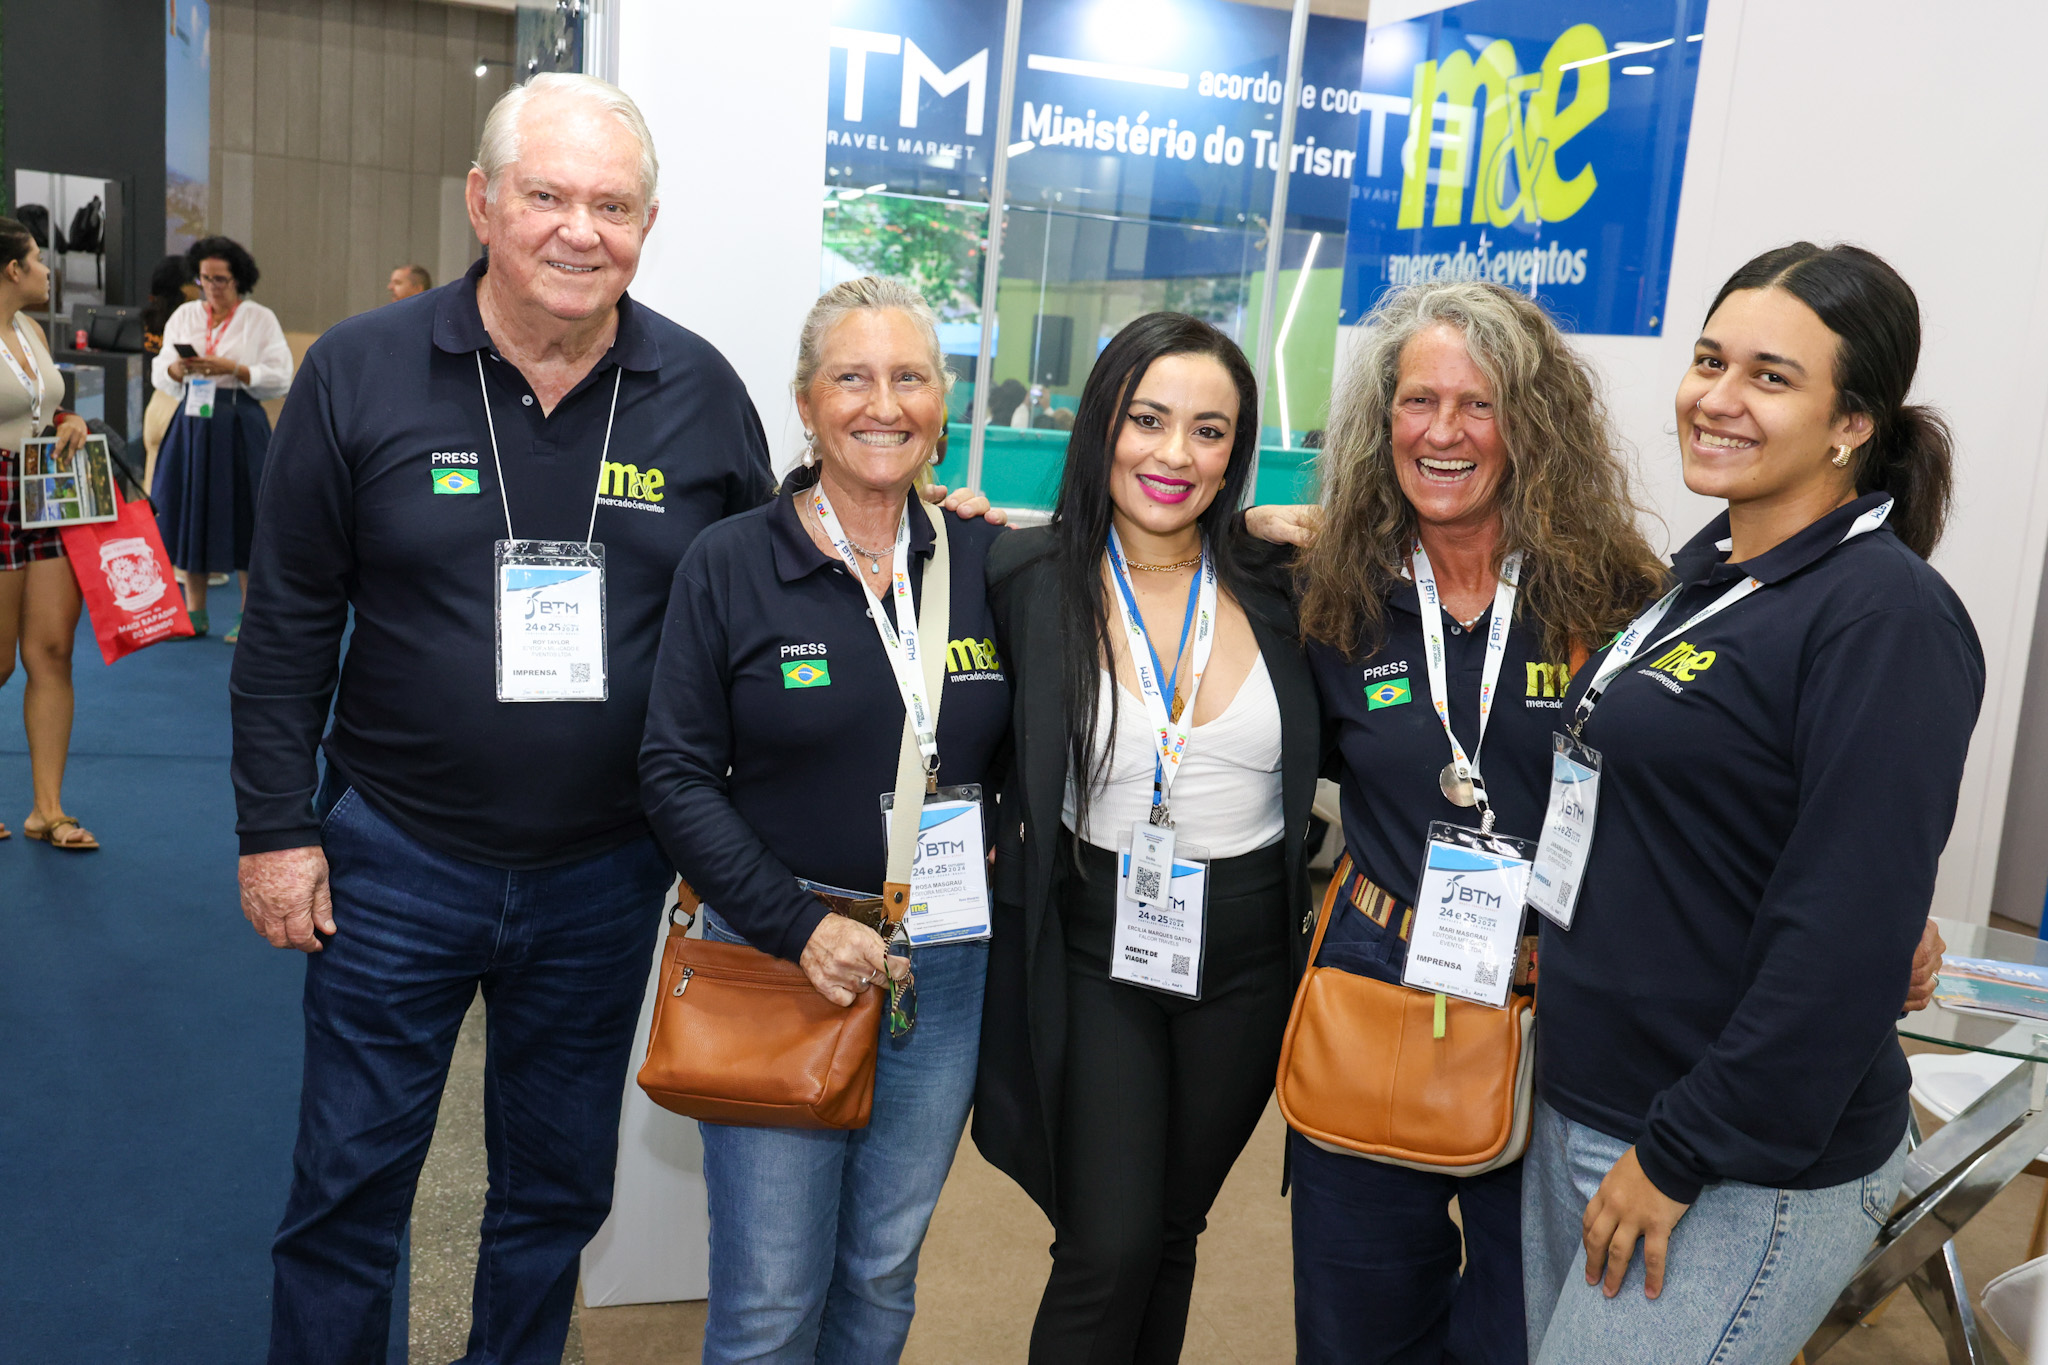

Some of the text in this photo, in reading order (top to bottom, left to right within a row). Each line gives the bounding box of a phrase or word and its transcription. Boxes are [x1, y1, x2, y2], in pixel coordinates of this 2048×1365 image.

[1198, 70, 1282, 105] acordo
[1021, 101, 1197, 160] Ministério
[1203, 125, 1245, 166] do
[1397, 22, 1610, 231] m&e
[898, 138, 976, 160] MARKET
[1389, 240, 1588, 285] mercado&eventos
[432, 452, 478, 464] PRESS
[599, 460, 665, 502] m&e
[1425, 585, 1436, 604] BTM
[540, 601, 579, 614] BTM
[525, 623, 538, 631] 24
[548, 623, 561, 631] 25
[1491, 616, 1502, 641] BTM
[1621, 629, 1639, 648] BTM
[781, 643, 827, 658] PRESS
[906, 638, 916, 661] BTM
[1140, 666, 1152, 688] BTM
[1363, 660, 1409, 681] PRESS
[926, 840, 964, 857] BTM
[912, 867, 926, 877] 24
[927, 867, 933, 875] e
[935, 864, 947, 874] 25
[915, 879, 962, 891] ROSA MASGRAU
[1459, 886, 1501, 909] BTM
[1138, 910, 1150, 920] 24
[1157, 914, 1169, 924] 25
[1439, 907, 1477, 923] 24 e 25
[1169, 920, 1184, 928] 2024
[1478, 919, 1497, 928] 2024
[1148, 929, 1173, 940] MARQUES
[1432, 931, 1457, 941] EDITORA
[1439, 926, 1488, 941] MARI MASGRAU
[1125, 945, 1149, 956] AGENTE
[1158, 938, 1179, 947] TRAVELS
[1124, 954, 1148, 965] VIAGEM
[1416, 954, 1462, 971] IMPRENSA
